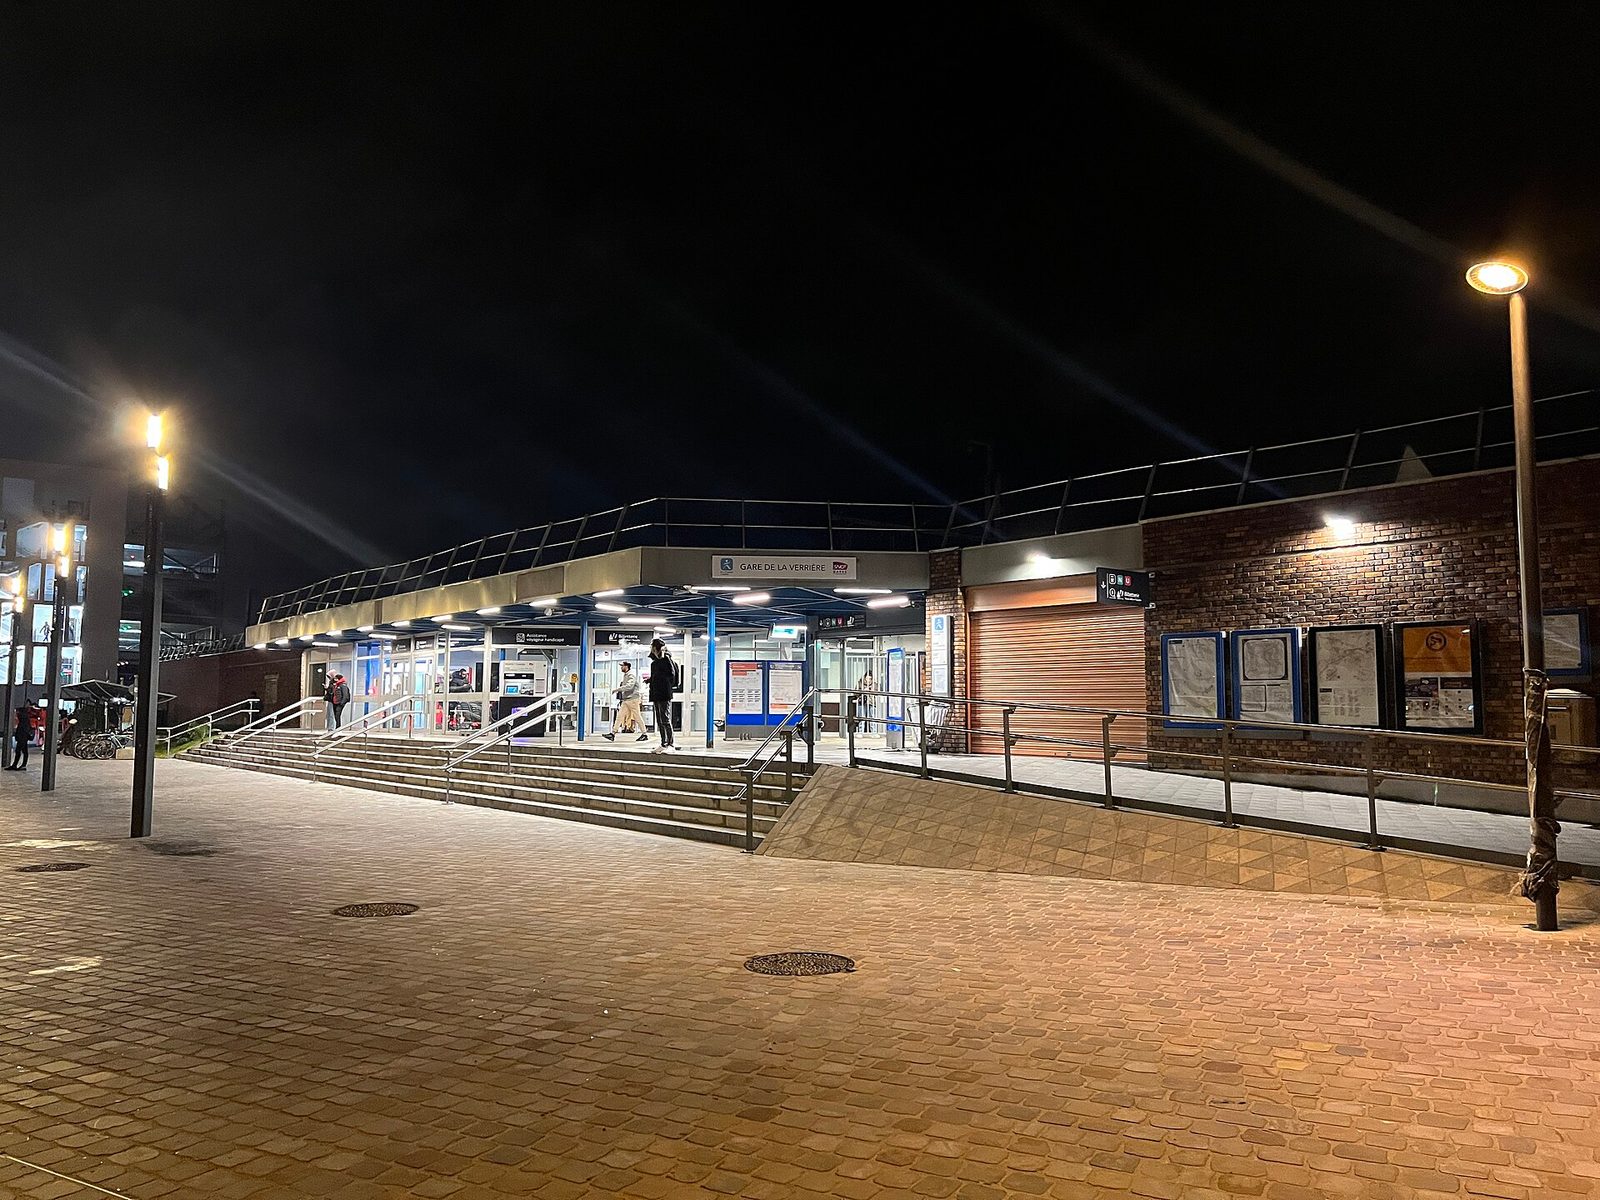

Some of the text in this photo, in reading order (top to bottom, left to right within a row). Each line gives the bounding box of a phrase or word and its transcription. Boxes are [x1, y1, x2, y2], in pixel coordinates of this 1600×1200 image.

[740, 563, 762, 571] GARE
[764, 563, 775, 571] DE
[777, 563, 789, 571] LA
